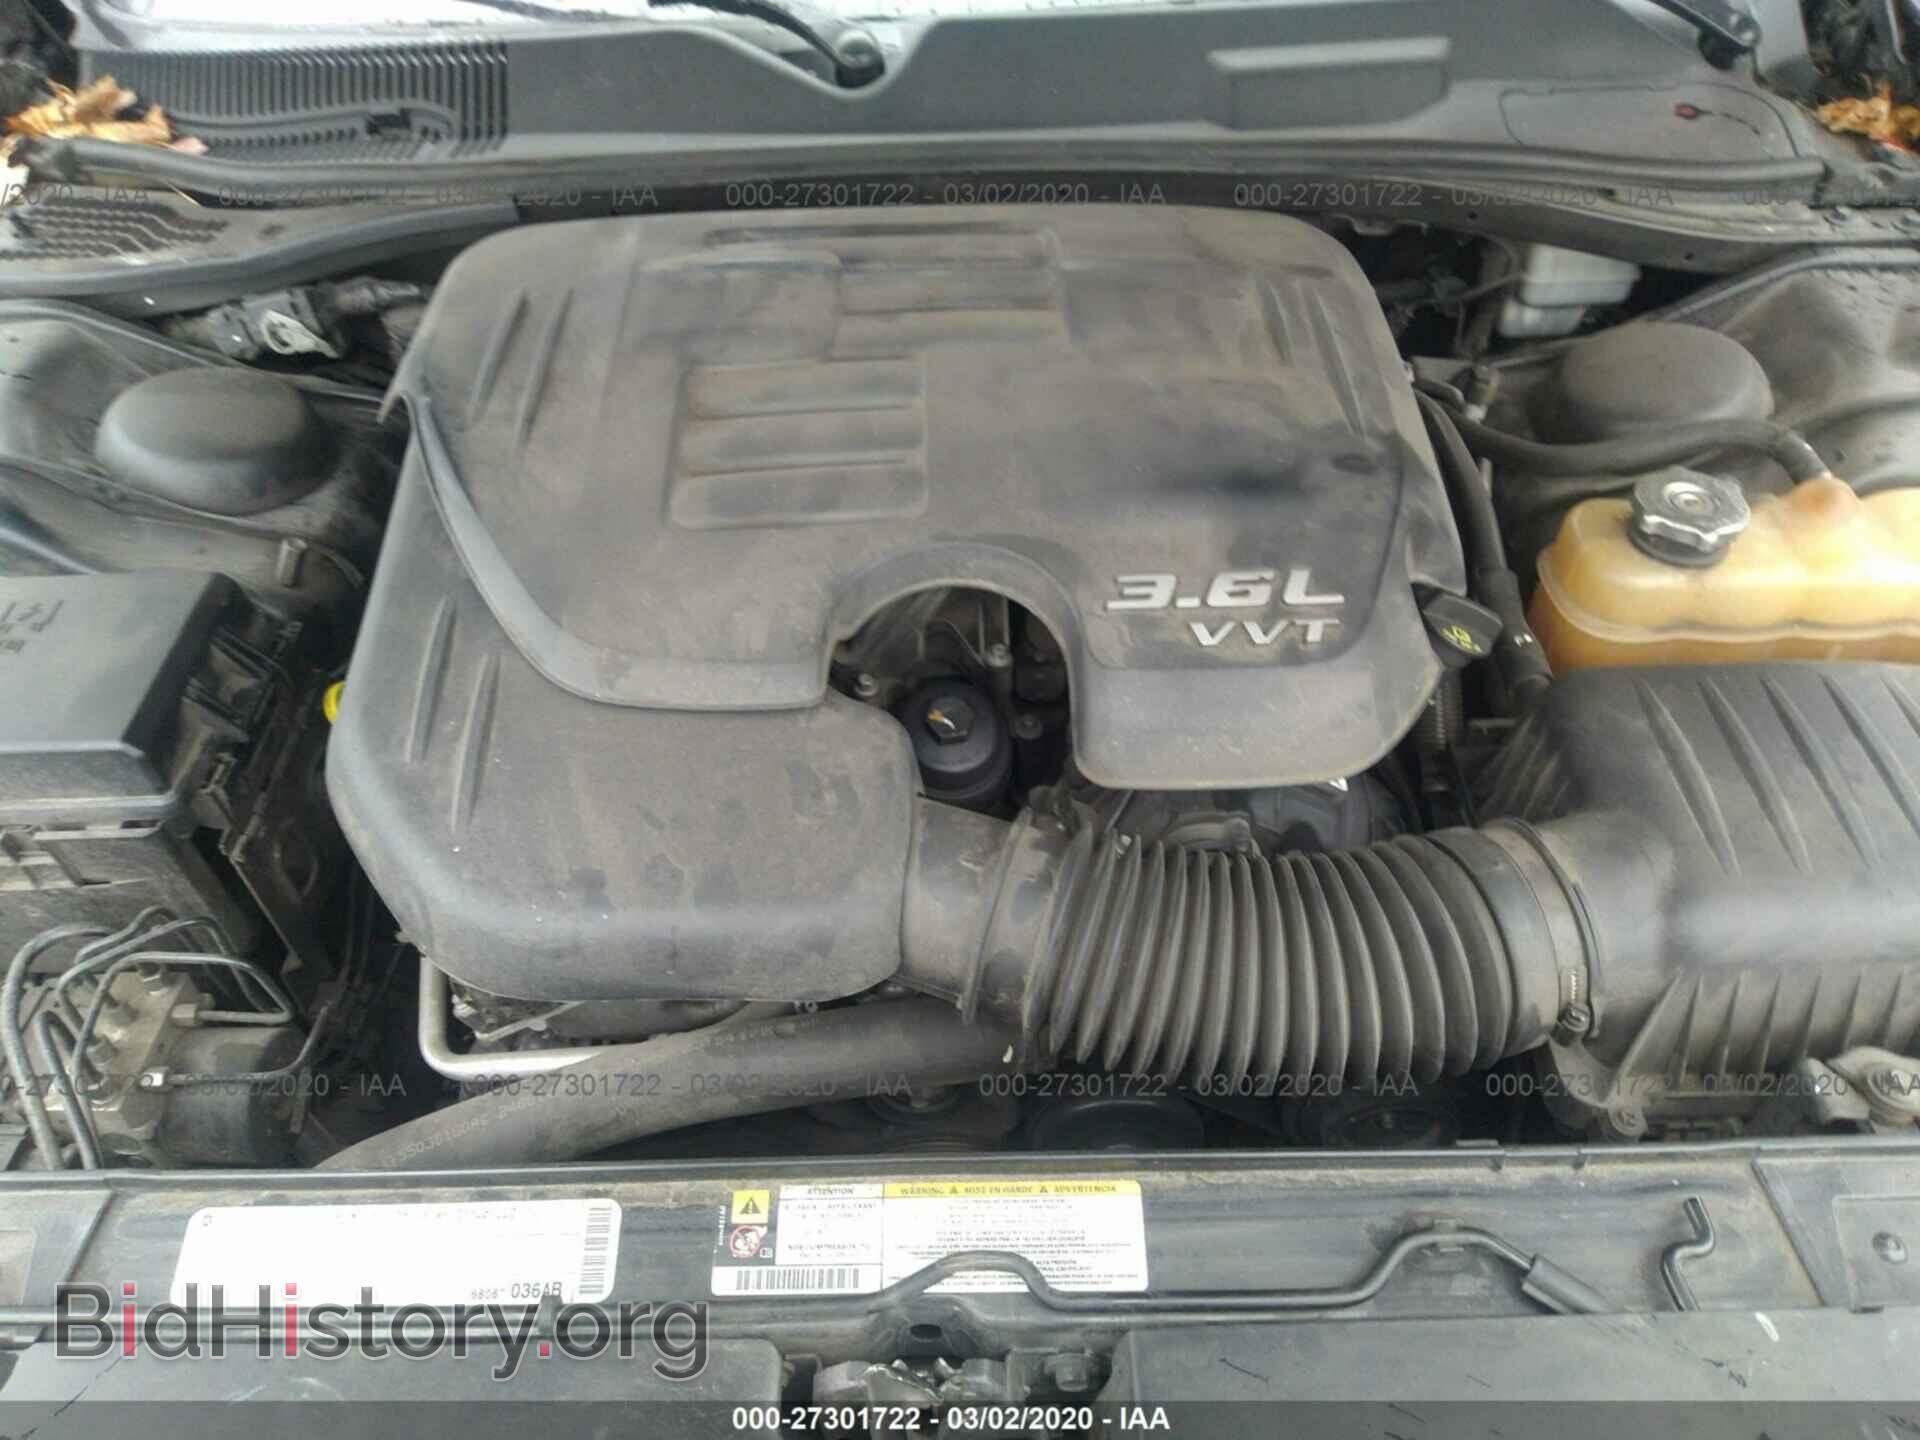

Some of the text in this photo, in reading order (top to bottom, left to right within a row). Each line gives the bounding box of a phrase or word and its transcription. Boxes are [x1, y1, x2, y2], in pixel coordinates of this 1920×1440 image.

[1107, 569, 1345, 611] 3.6L
[1188, 618, 1341, 647] VVT
[900, 1187, 945, 1195] WARNING
[511, 1281, 562, 1299] 036AB
